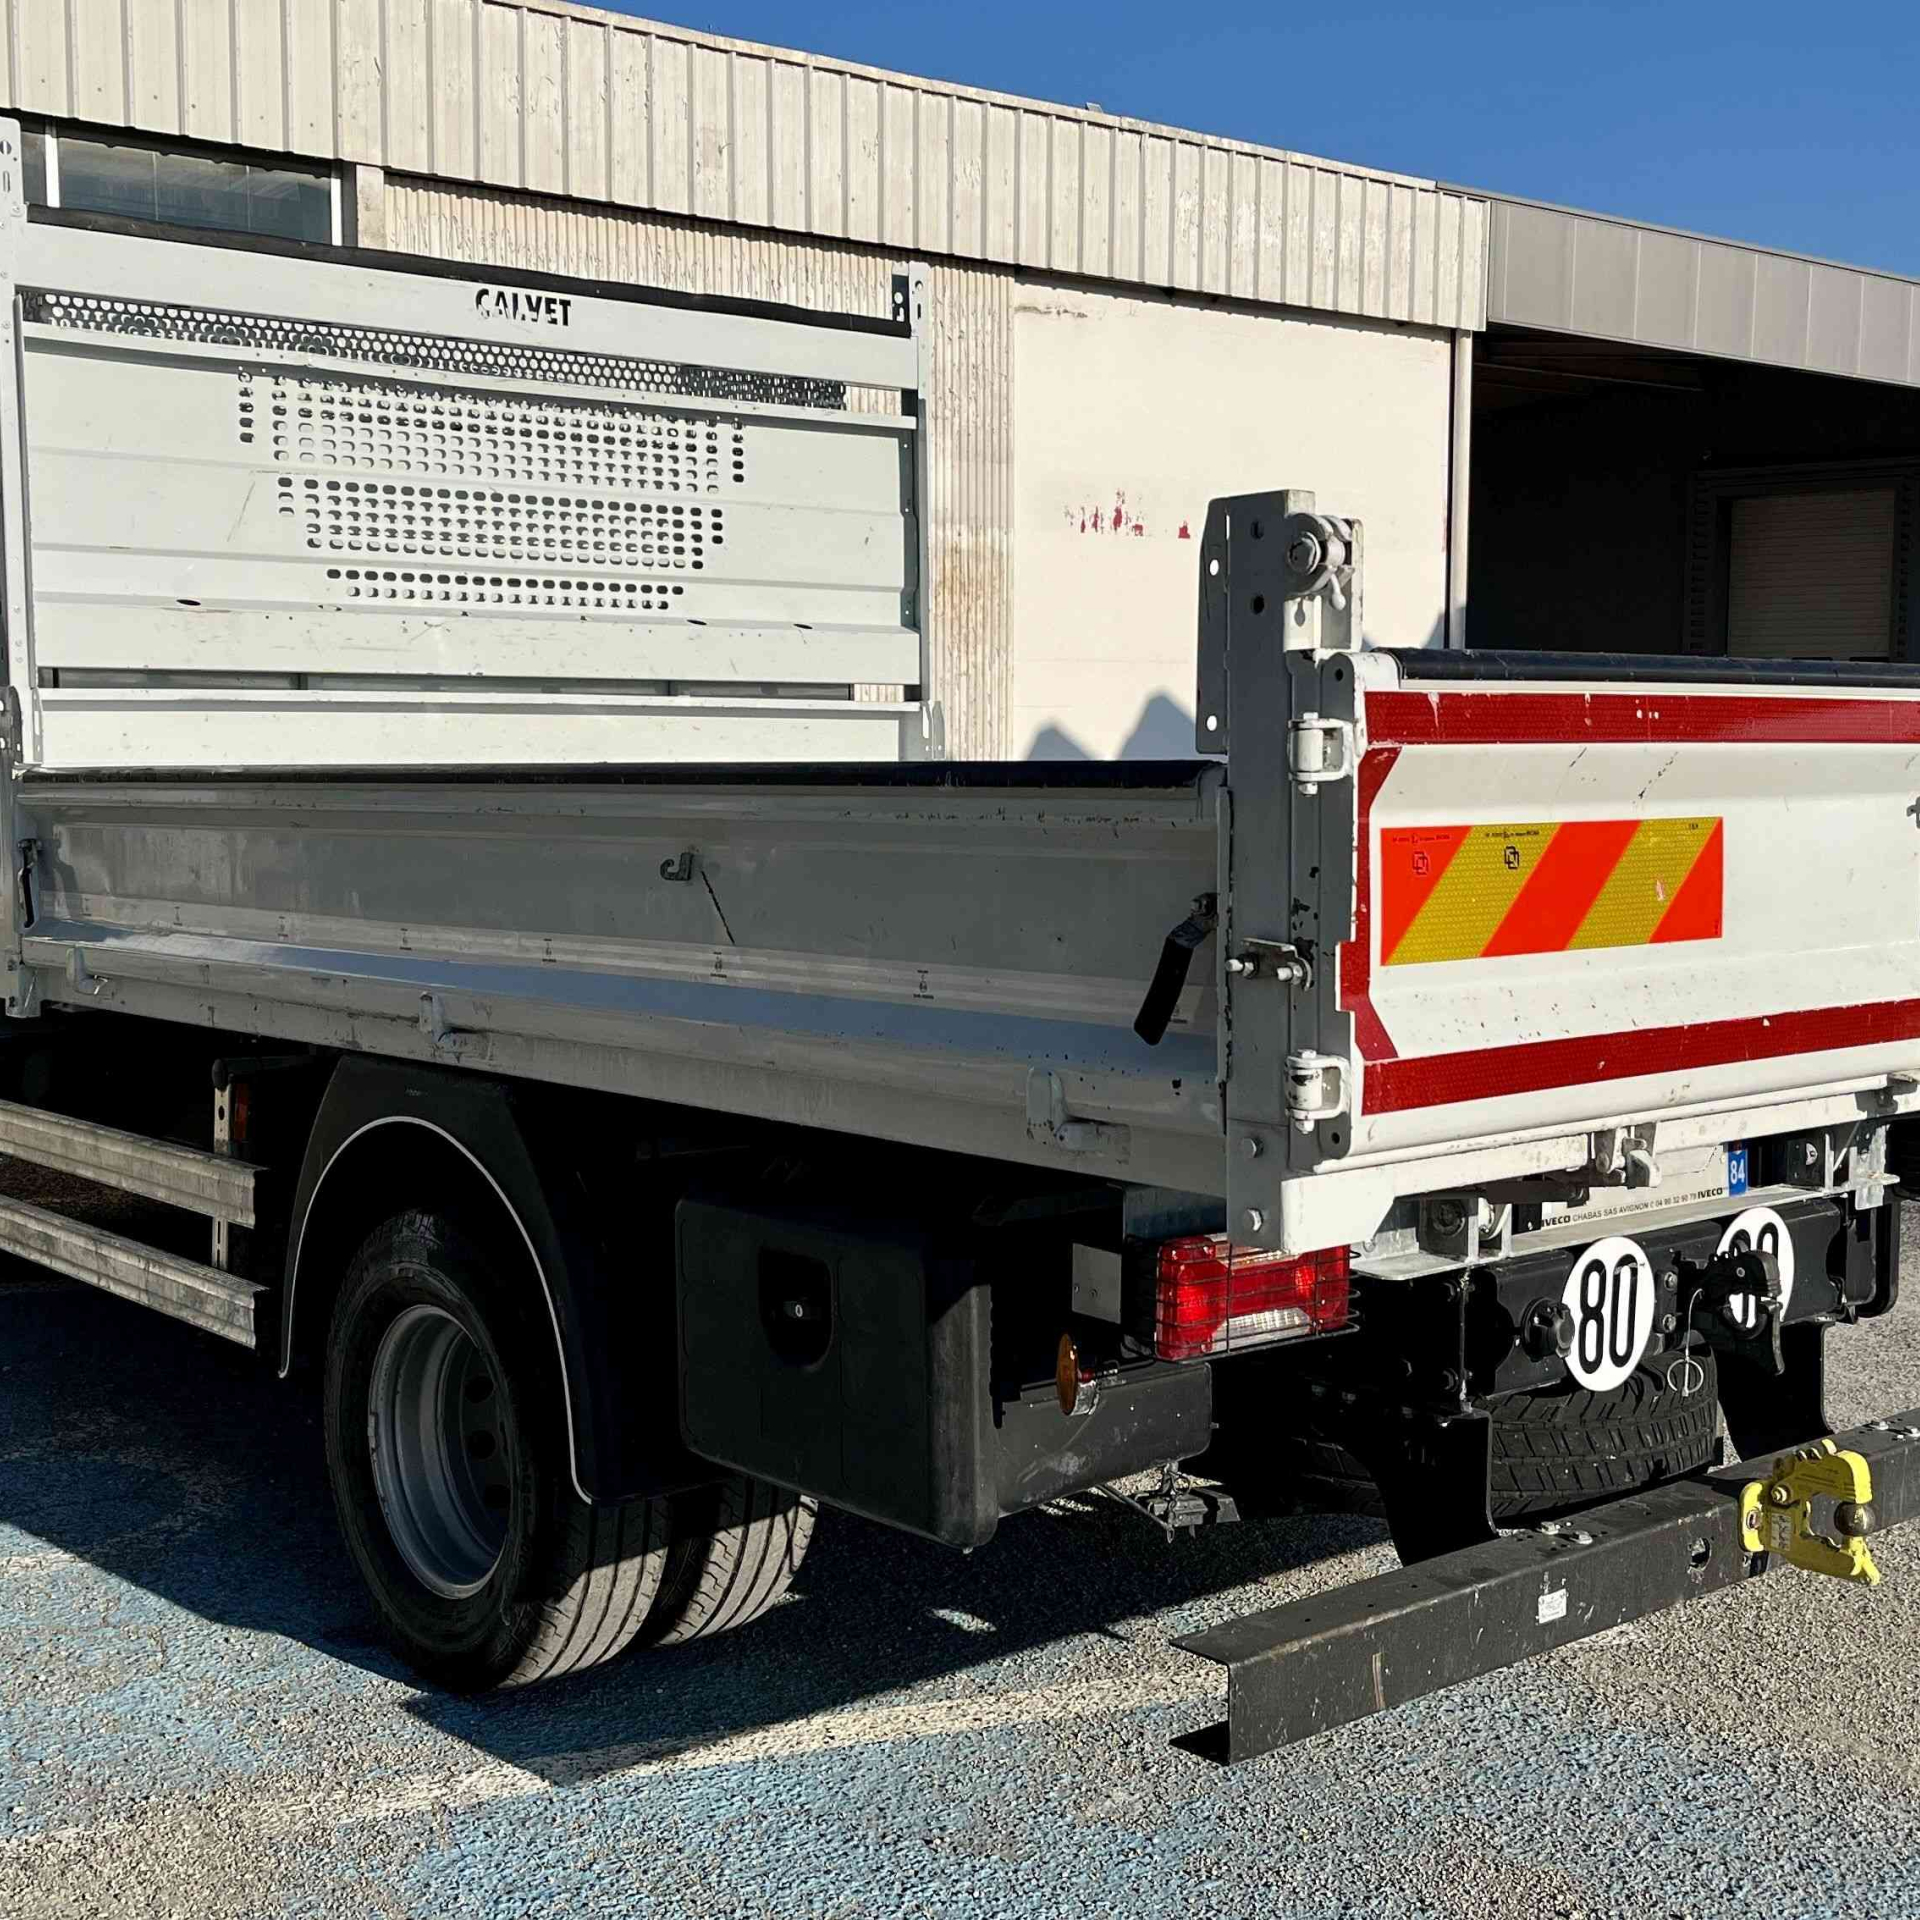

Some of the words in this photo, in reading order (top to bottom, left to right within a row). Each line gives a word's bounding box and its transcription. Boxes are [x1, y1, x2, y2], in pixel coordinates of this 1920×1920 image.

[475, 288, 571, 326] CALVET
[1730, 1160, 1746, 1185] 84
[1541, 1215, 1571, 1227] IVECO
[1572, 1211, 1602, 1222] CHABAS
[1603, 1207, 1618, 1217] SAS
[1619, 1202, 1649, 1214] AVIGNON
[1697, 1187, 1723, 1199] IVECO
[1579, 1254, 1638, 1374] 80
